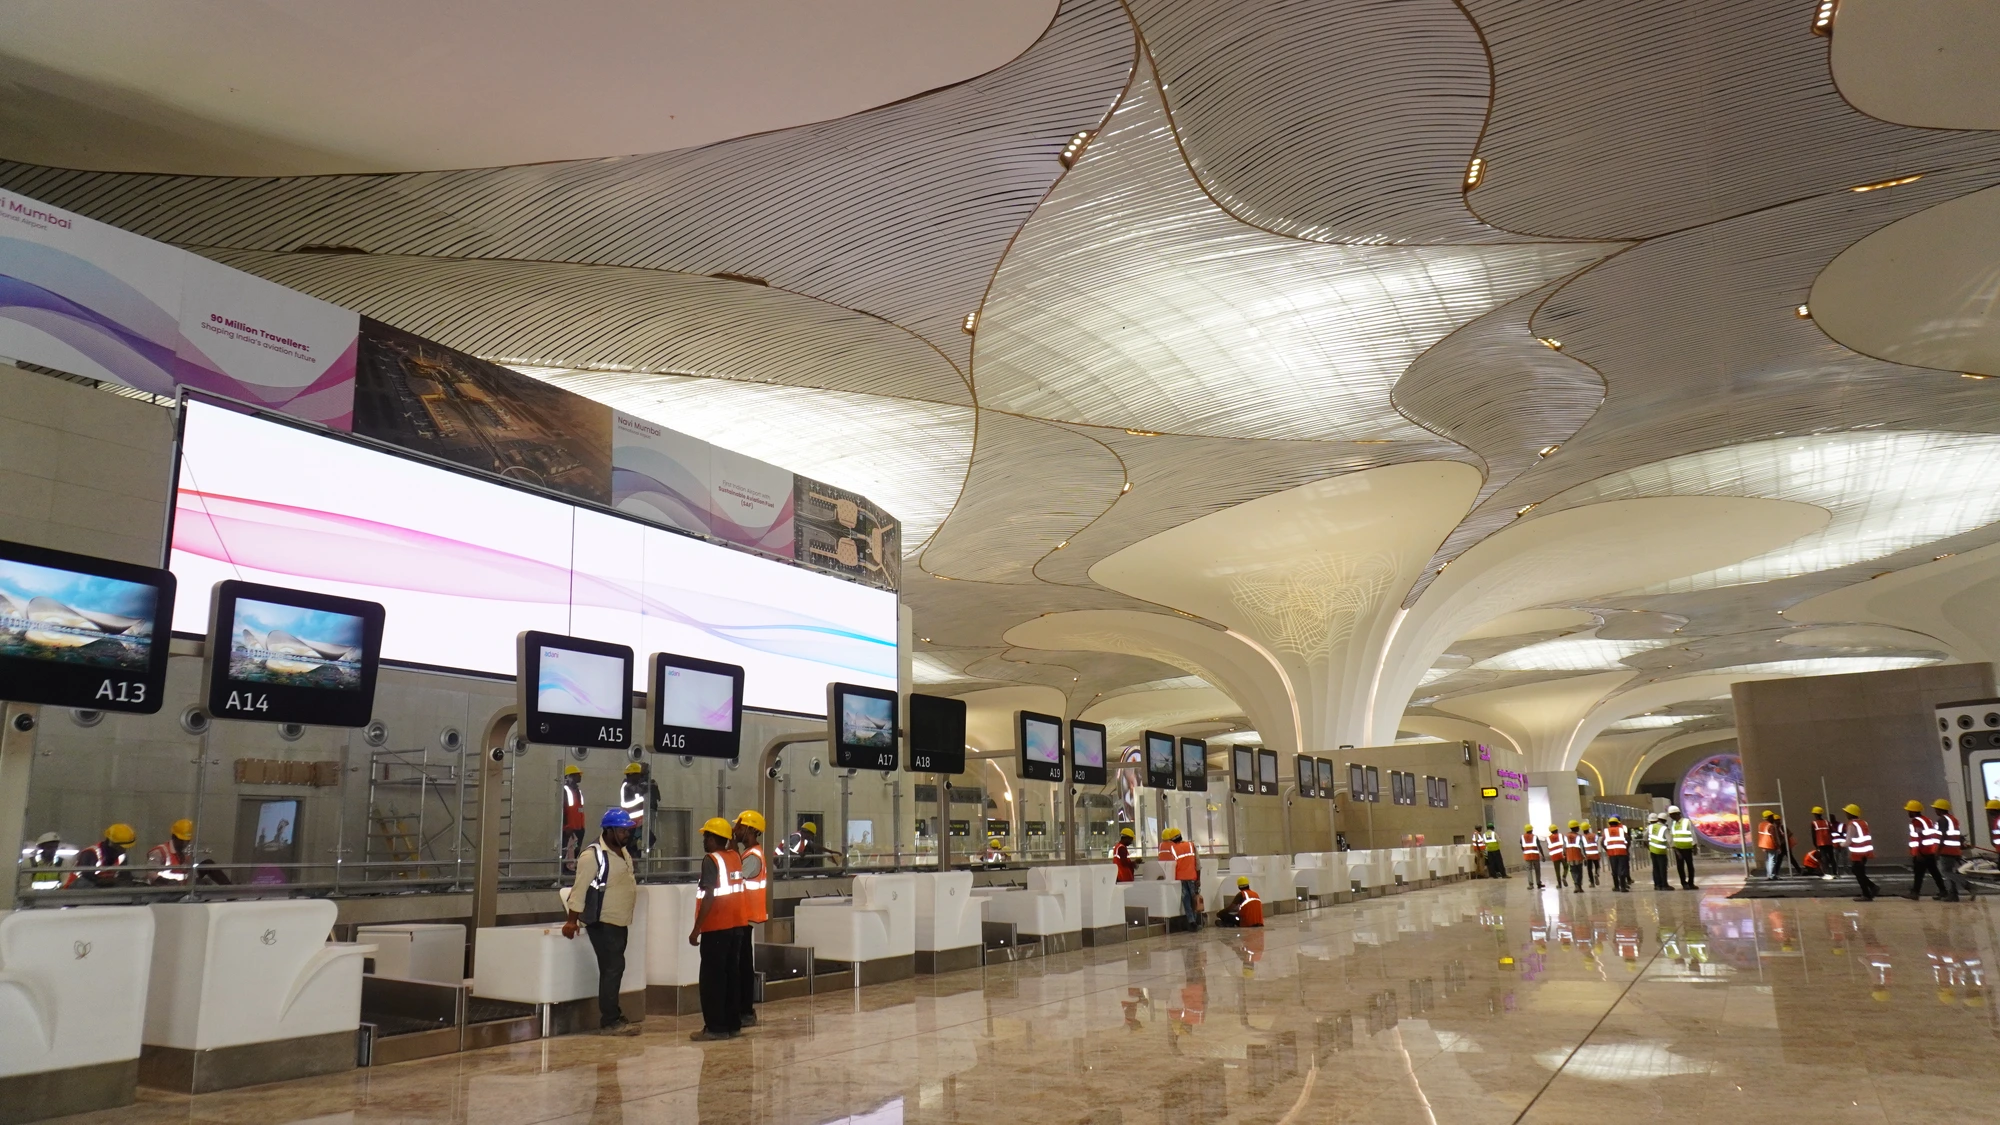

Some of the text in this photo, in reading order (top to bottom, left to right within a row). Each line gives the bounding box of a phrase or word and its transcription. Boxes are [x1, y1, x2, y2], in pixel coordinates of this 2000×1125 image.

[9, 200, 72, 229] Mumbai
[210, 313, 310, 352] 90 Million Travellers:
[201, 321, 316, 363] Shaping India's aviation future
[617, 416, 661, 437] Navi Mumbai
[718, 485, 746, 499] Sustainable
[544, 650, 559, 659] adani
[667, 669, 681, 677] adani
[95, 679, 146, 703] A13
[225, 690, 269, 712] A14
[598, 726, 623, 743] A15
[662, 732, 686, 749] A16
[877, 753, 893, 766] A17
[915, 755, 931, 768] A18
[1049, 767, 1061, 778] A19
[1074, 770, 1086, 780] A20
